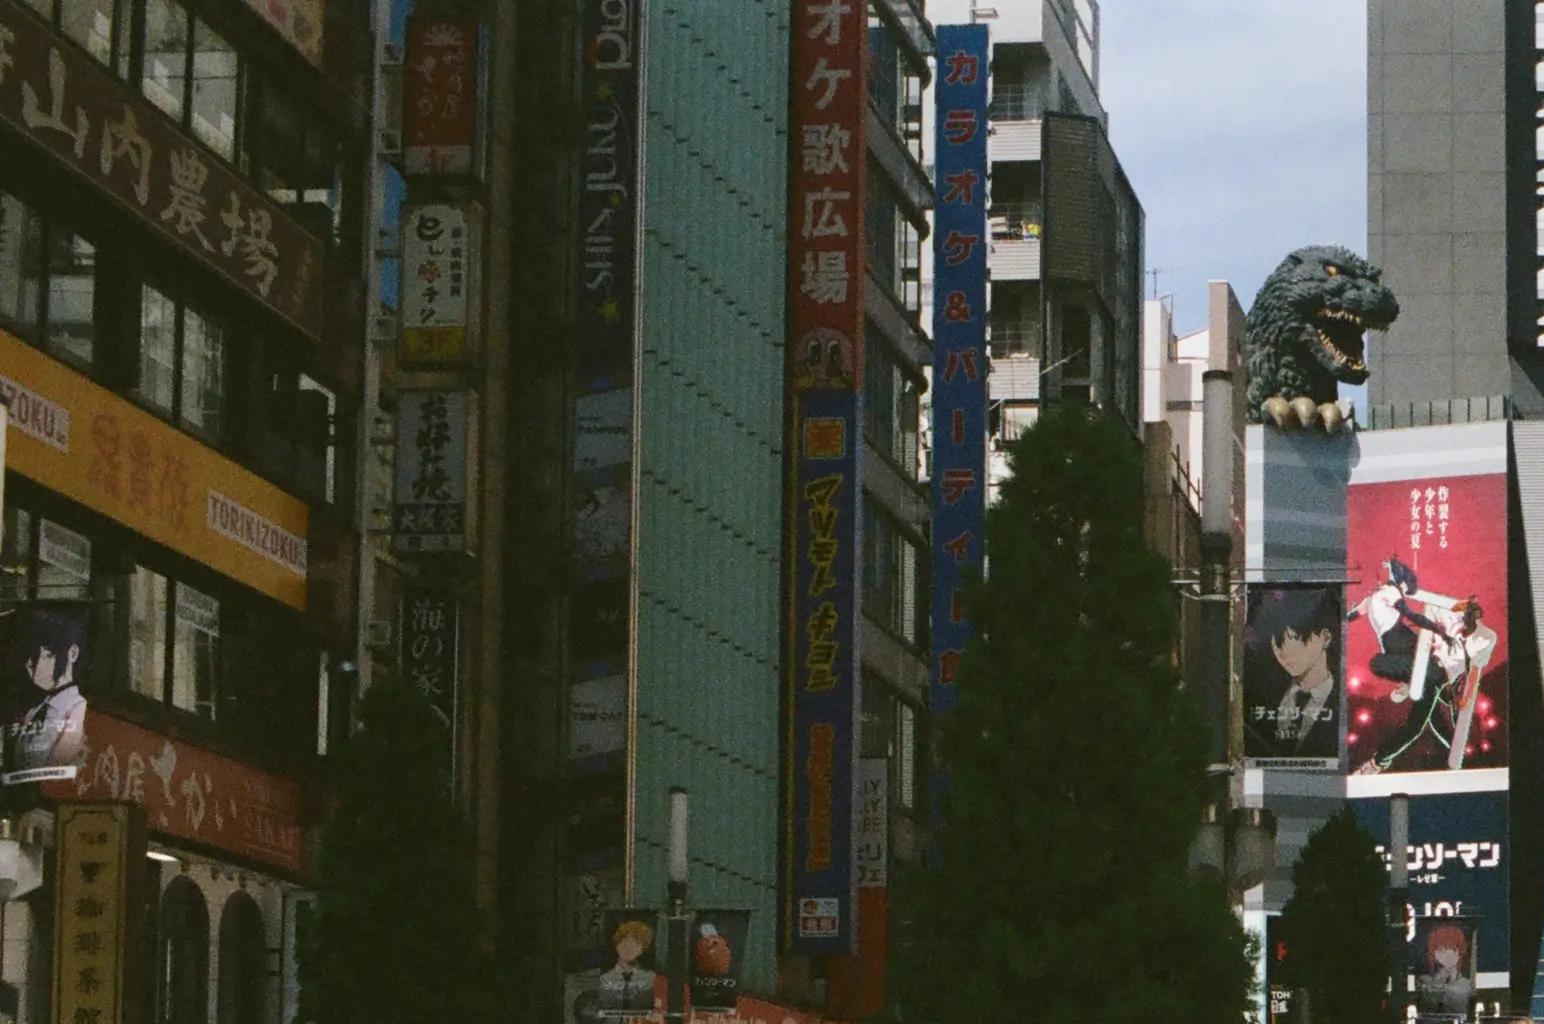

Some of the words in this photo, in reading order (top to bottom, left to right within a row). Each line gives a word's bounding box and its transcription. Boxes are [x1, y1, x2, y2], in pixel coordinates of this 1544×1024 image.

[0, 24, 279, 298] 山内農場
[0, 379, 56, 438] ZOKU
[1375, 841, 1501, 871] ンソーマン
